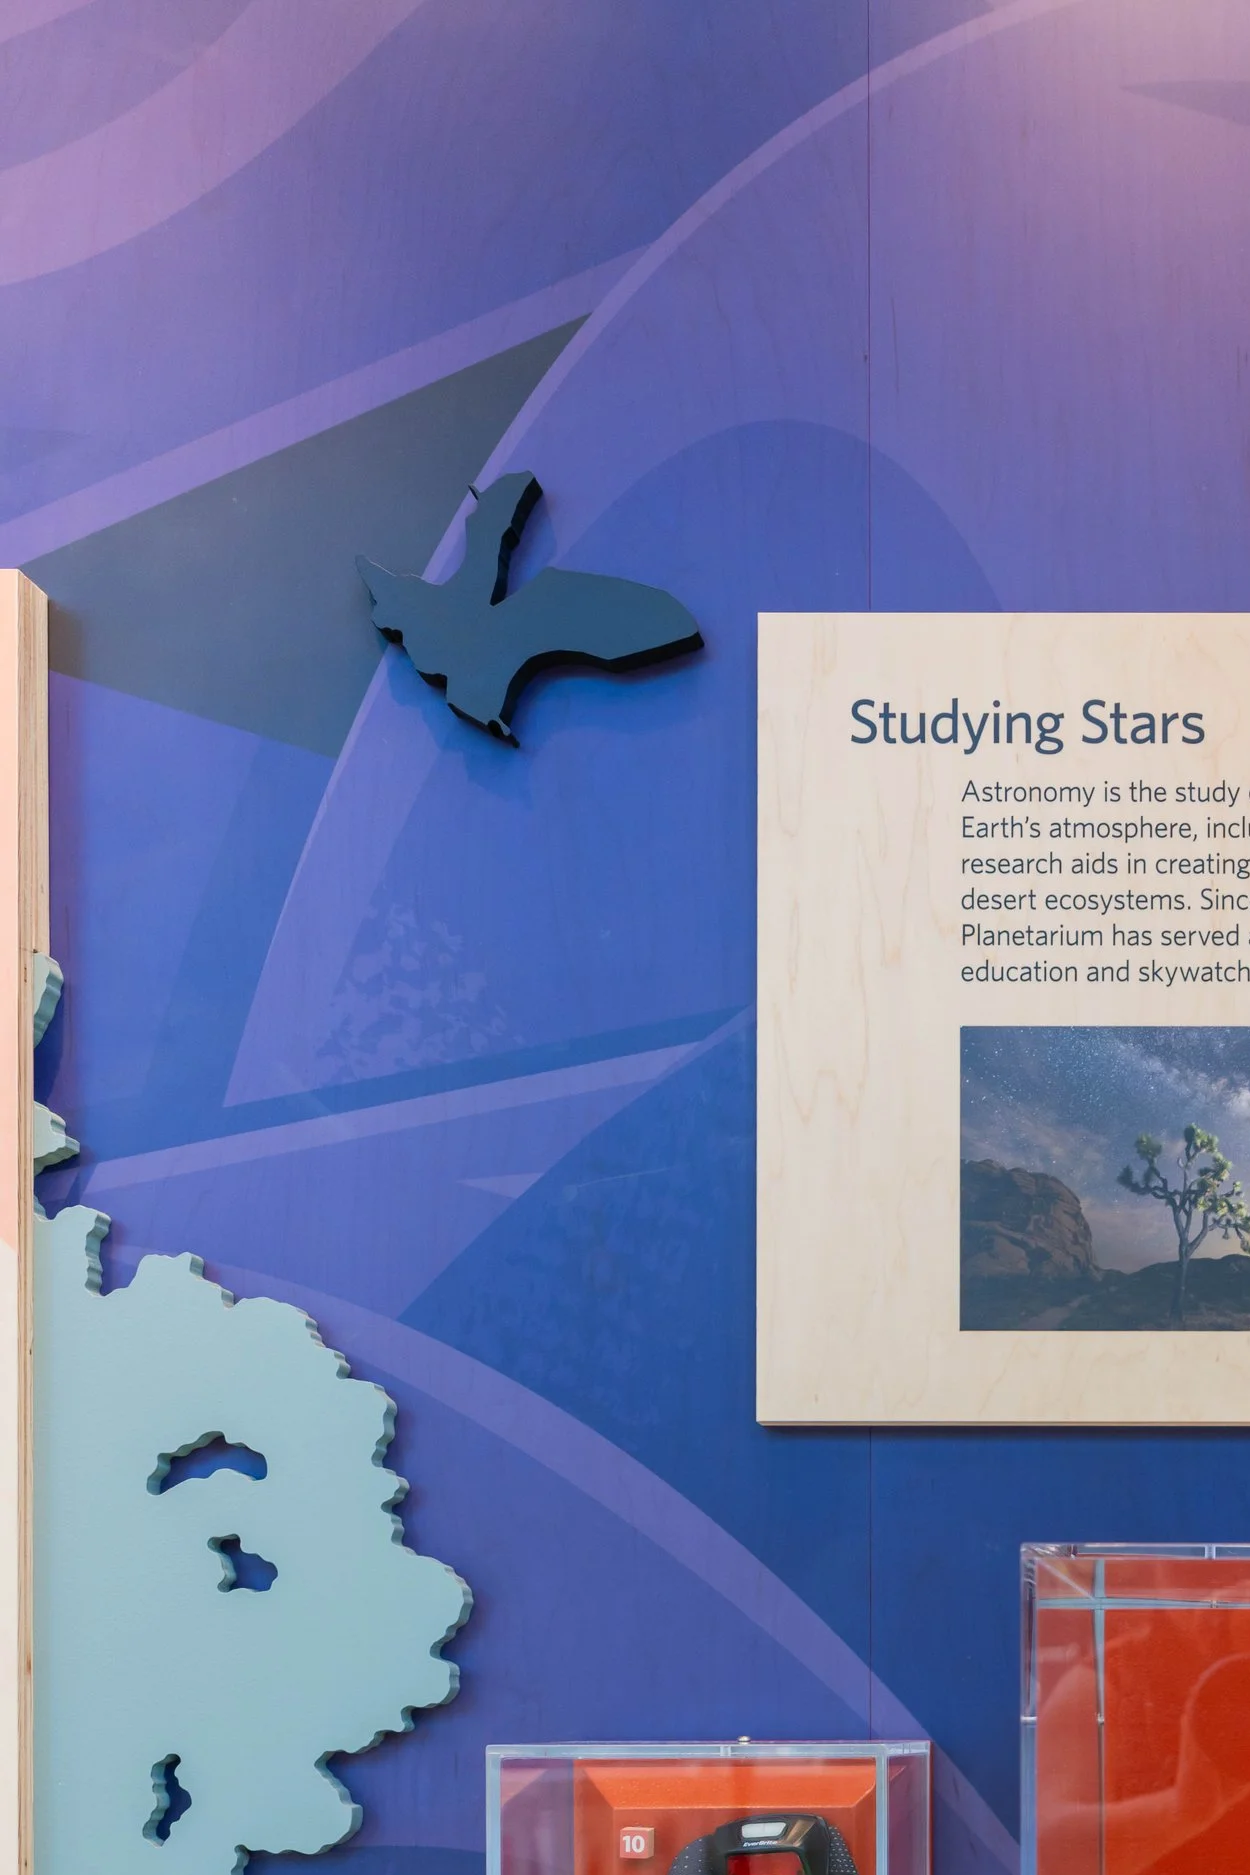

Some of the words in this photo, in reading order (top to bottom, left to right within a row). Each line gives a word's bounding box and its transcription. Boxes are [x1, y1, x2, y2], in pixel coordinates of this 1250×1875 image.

[850, 697, 1065, 756] Studying
[1081, 698, 1206, 745] Stars
[961, 779, 1096, 808] Astronomy
[1104, 780, 1121, 803] is
[1128, 779, 1167, 803] the
[1175, 779, 1241, 808] study
[1049, 815, 1198, 844] atmosphere,
[961, 851, 1063, 875] research
[1071, 851, 1119, 875] aids
[1127, 852, 1147, 875] in
[1155, 852, 1250, 880] creating
[961, 887, 1037, 911] desert
[1045, 889, 1191, 916] ecosystems.
[962, 923, 1103, 947] Planetarium
[1112, 923, 1153, 947] has
[1160, 923, 1240, 947] served
[960, 959, 1078, 983] education
[1086, 959, 1130, 983] and
[622, 1835, 645, 1853] 10
